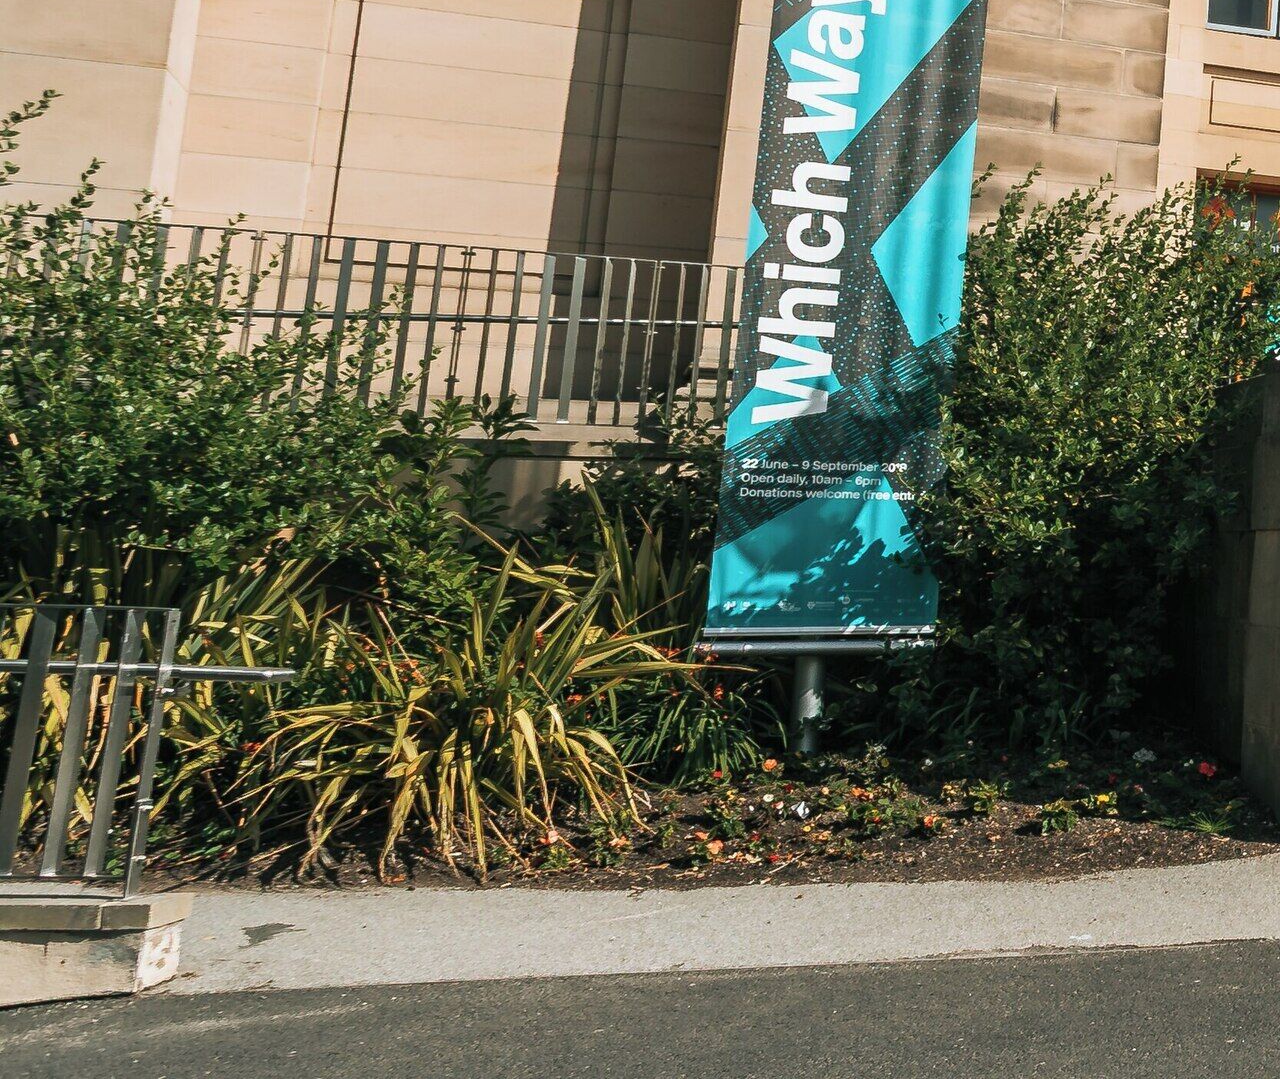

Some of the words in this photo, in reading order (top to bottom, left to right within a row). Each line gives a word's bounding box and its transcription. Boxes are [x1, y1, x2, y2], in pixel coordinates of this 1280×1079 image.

[750, 160, 852, 425] Which
[741, 458, 759, 470] 22
[760, 459, 789, 470] June
[802, 460, 810, 471] 9
[812, 460, 879, 473] September
[741, 472, 774, 485] Open
[777, 473, 809, 486] daily,
[811, 475, 843, 485] 10am
[854, 476, 882, 488] 6pm
[739, 487, 803, 499] Donations
[805, 489, 861, 500] welcome
[863, 490, 891, 501] (free
[892, 491, 916, 502] entr
